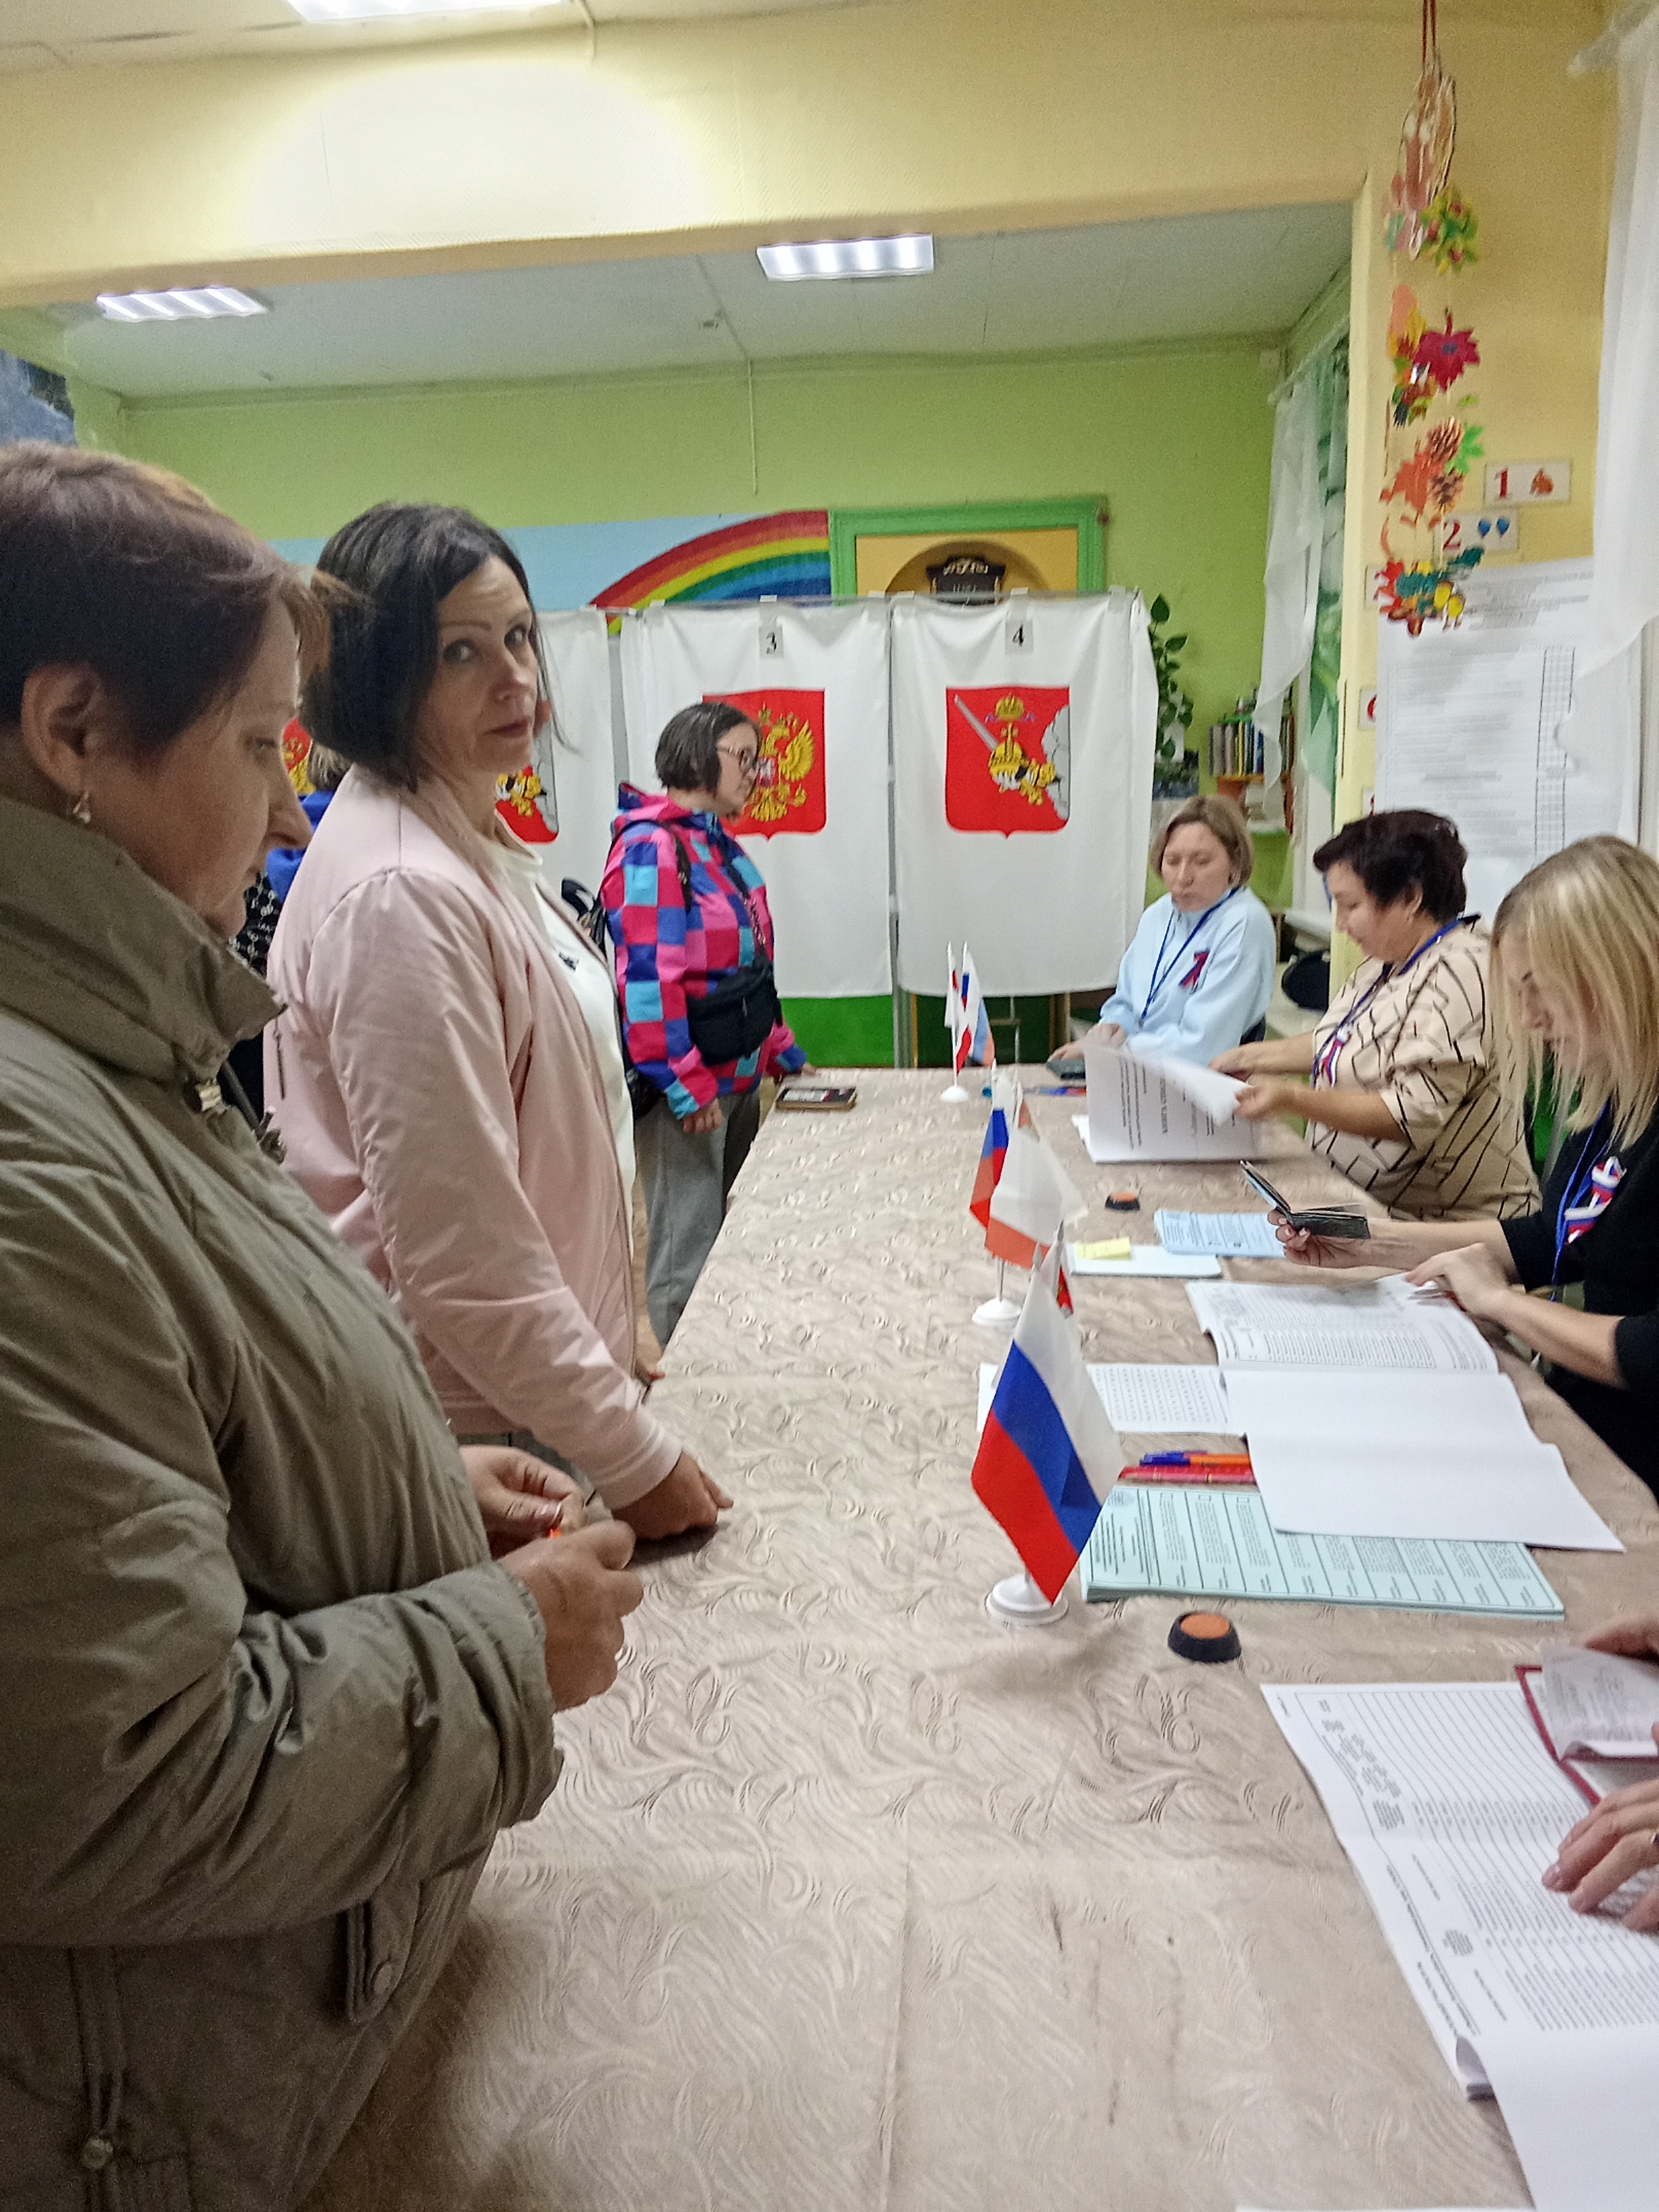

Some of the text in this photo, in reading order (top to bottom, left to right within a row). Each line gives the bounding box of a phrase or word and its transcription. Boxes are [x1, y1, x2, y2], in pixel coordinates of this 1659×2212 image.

[1494, 468, 1510, 499] 1
[1442, 520, 1462, 550] 2
[766, 632, 777, 654] 3
[1012, 623, 1025, 647] 4
